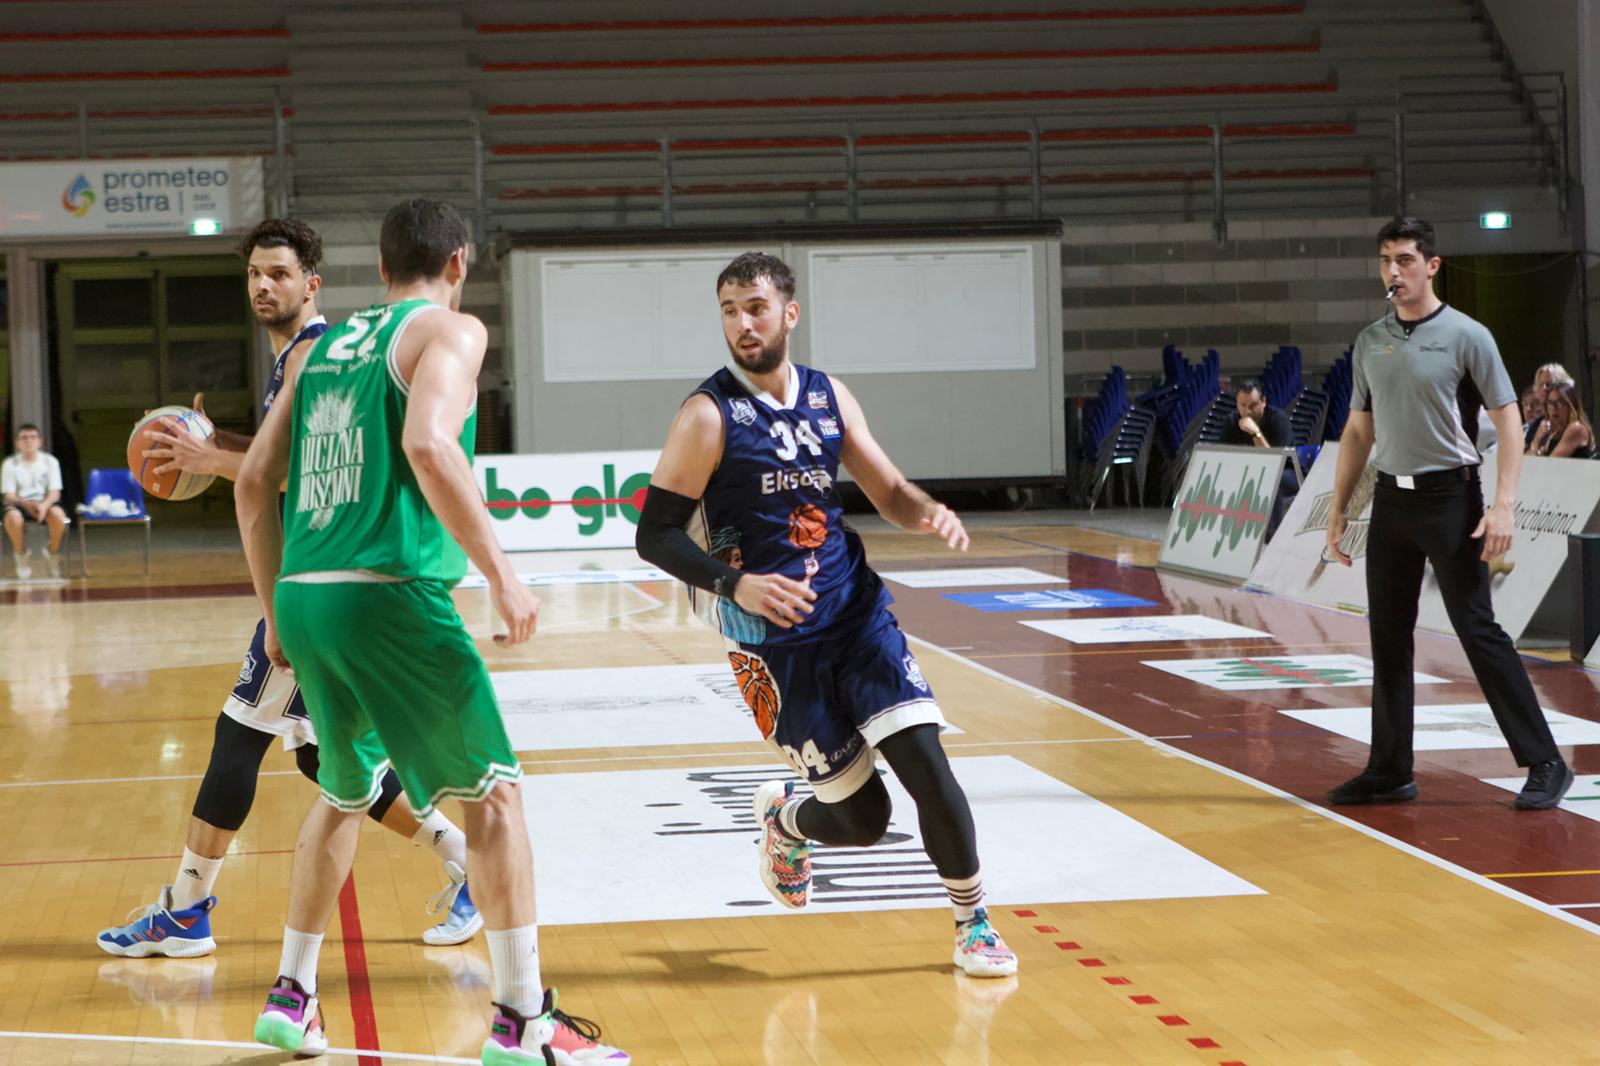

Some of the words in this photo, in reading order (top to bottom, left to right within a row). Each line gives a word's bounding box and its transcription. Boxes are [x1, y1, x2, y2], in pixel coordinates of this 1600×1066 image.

[103, 168, 228, 195] prometeo
[105, 192, 170, 213] estra
[769, 420, 822, 461] 34
